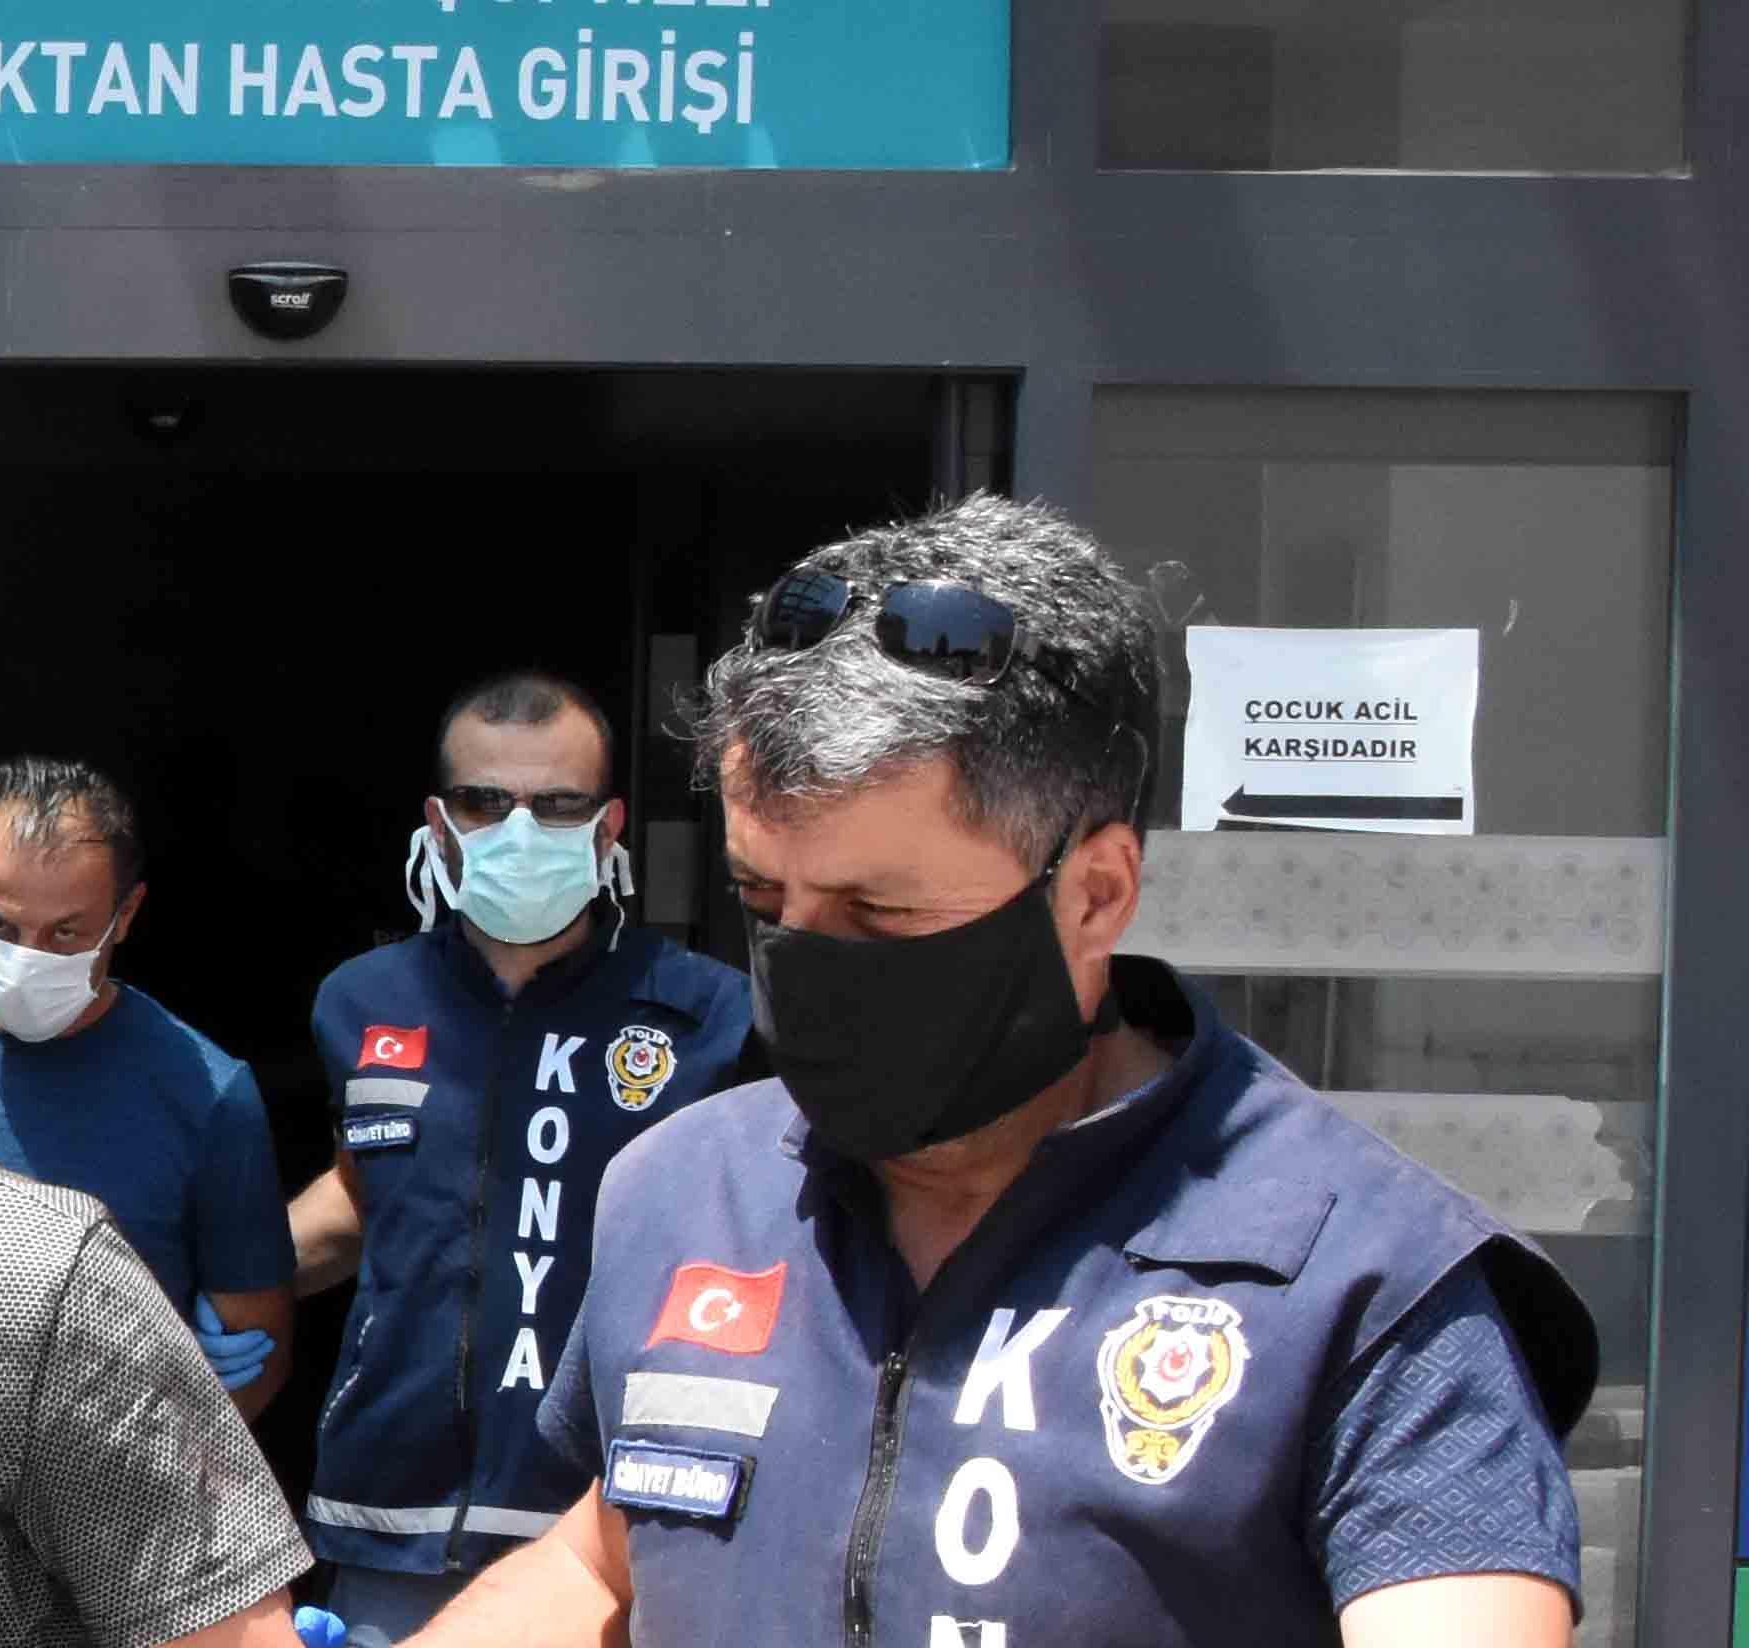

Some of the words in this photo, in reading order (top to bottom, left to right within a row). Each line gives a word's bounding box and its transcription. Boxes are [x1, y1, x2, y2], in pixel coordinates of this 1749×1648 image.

[229, 43, 494, 118] HASTA
[517, 28, 755, 134] GİRİŞİ
[1245, 700, 1344, 722] ÇOCUK
[1354, 697, 1419, 721] ACİL
[1244, 738, 1417, 761] KARŞIDADIR
[499, 1032, 586, 1391] KONYA
